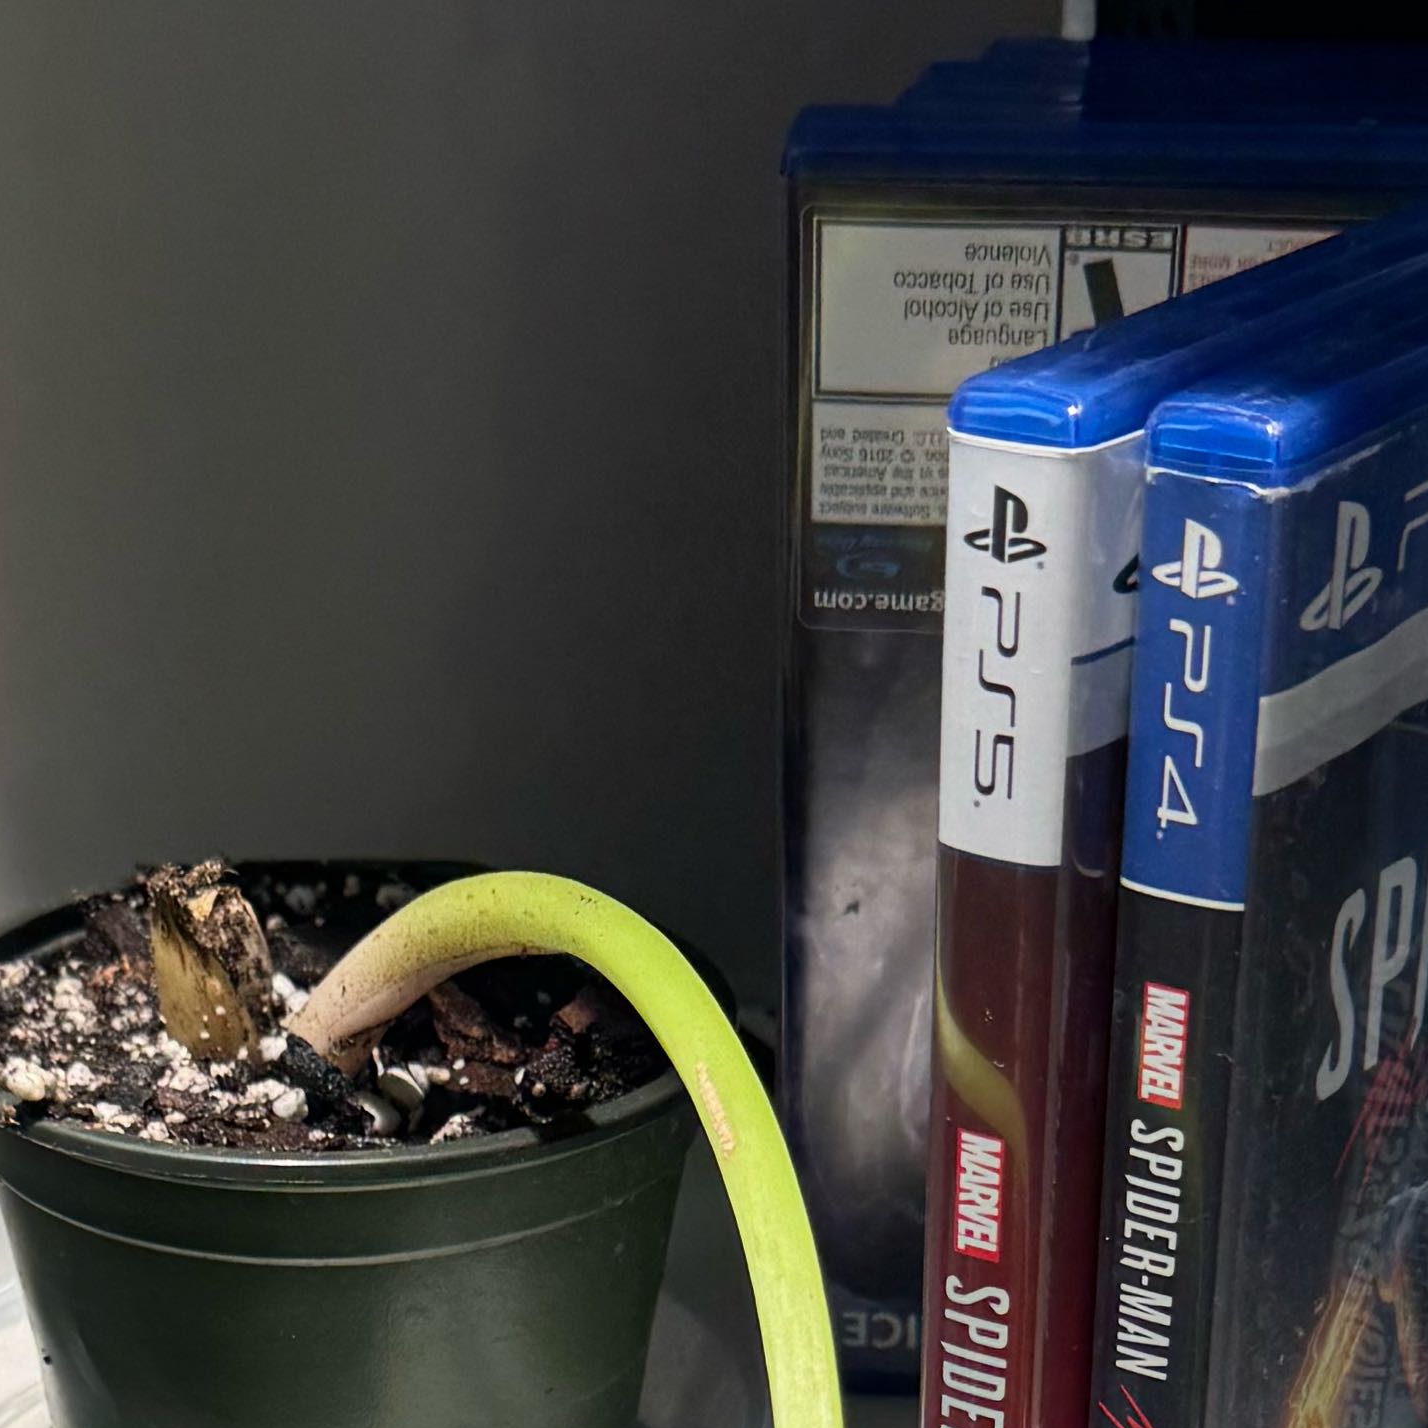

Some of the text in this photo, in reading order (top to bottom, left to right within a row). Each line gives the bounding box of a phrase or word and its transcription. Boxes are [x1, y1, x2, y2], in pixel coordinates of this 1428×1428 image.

[965, 243, 1052, 267] Violence
[893, 271, 1051, 296] Use of Tobacco
[904, 299, 1050, 323] Use of Alcohol
[1115, 984, 1189, 1381] MARVEL SPIDER-MAN
[956, 1130, 1005, 1261] MARVEL
